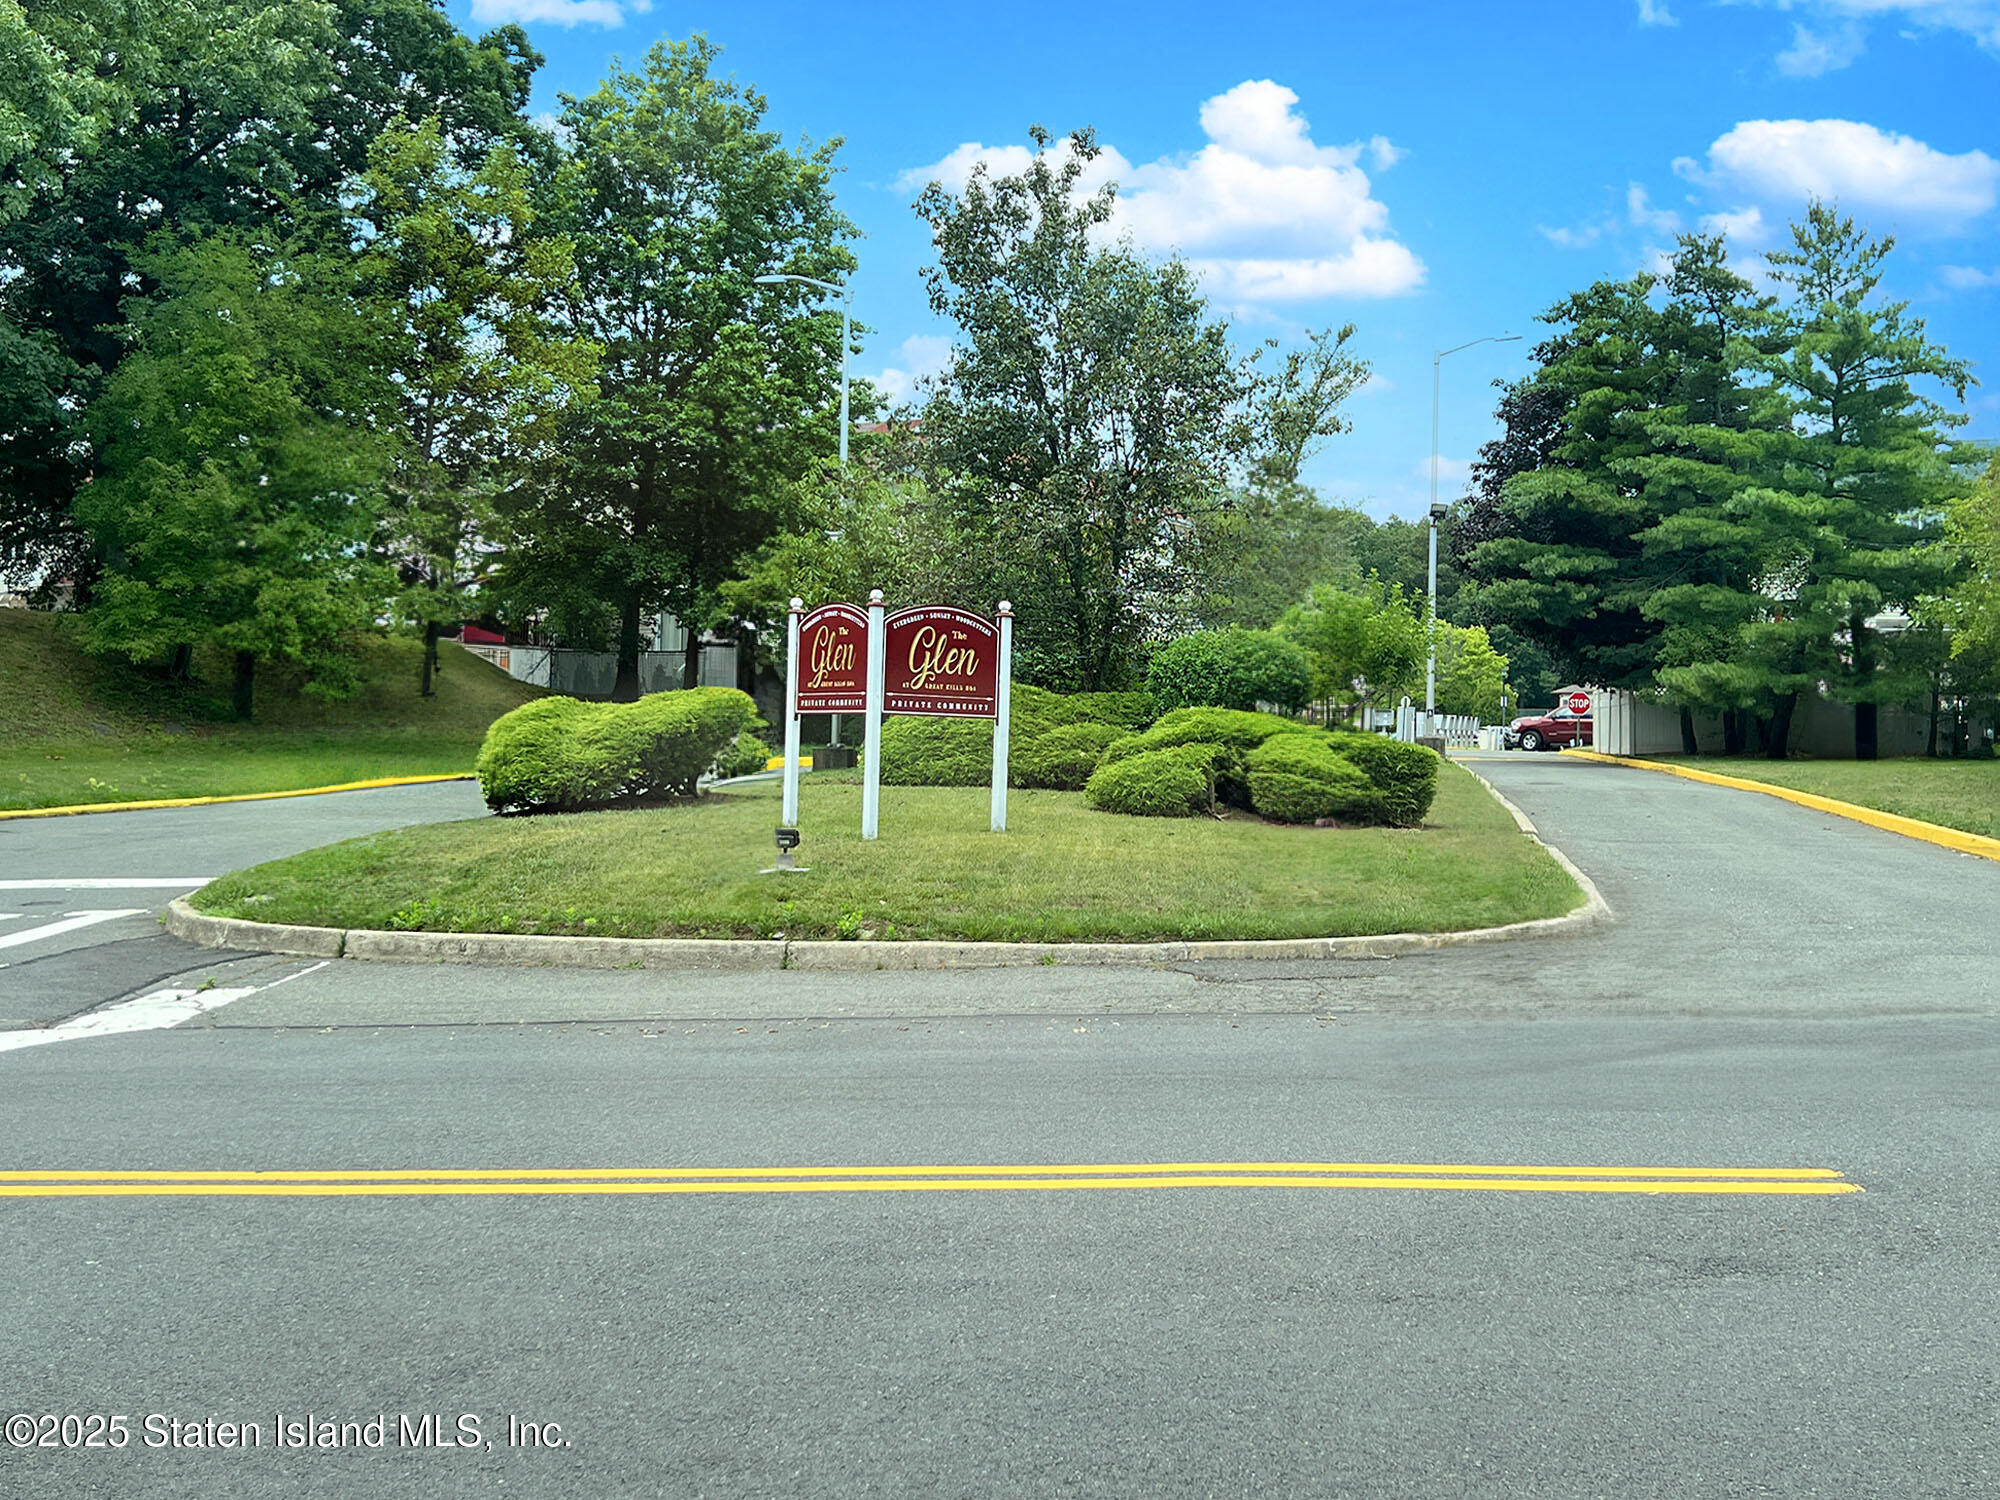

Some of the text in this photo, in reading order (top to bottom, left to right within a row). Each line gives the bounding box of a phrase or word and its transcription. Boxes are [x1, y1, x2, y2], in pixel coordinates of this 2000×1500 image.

[952, 630, 967, 640] The
[811, 625, 856, 688] Glen
[908, 625, 979, 690] Glen
[801, 698, 863, 707] PRIVATE COMMUNITY
[891, 699, 989, 711] PRIVATE COMMUNITY
[1569, 698, 1589, 709] STOP
